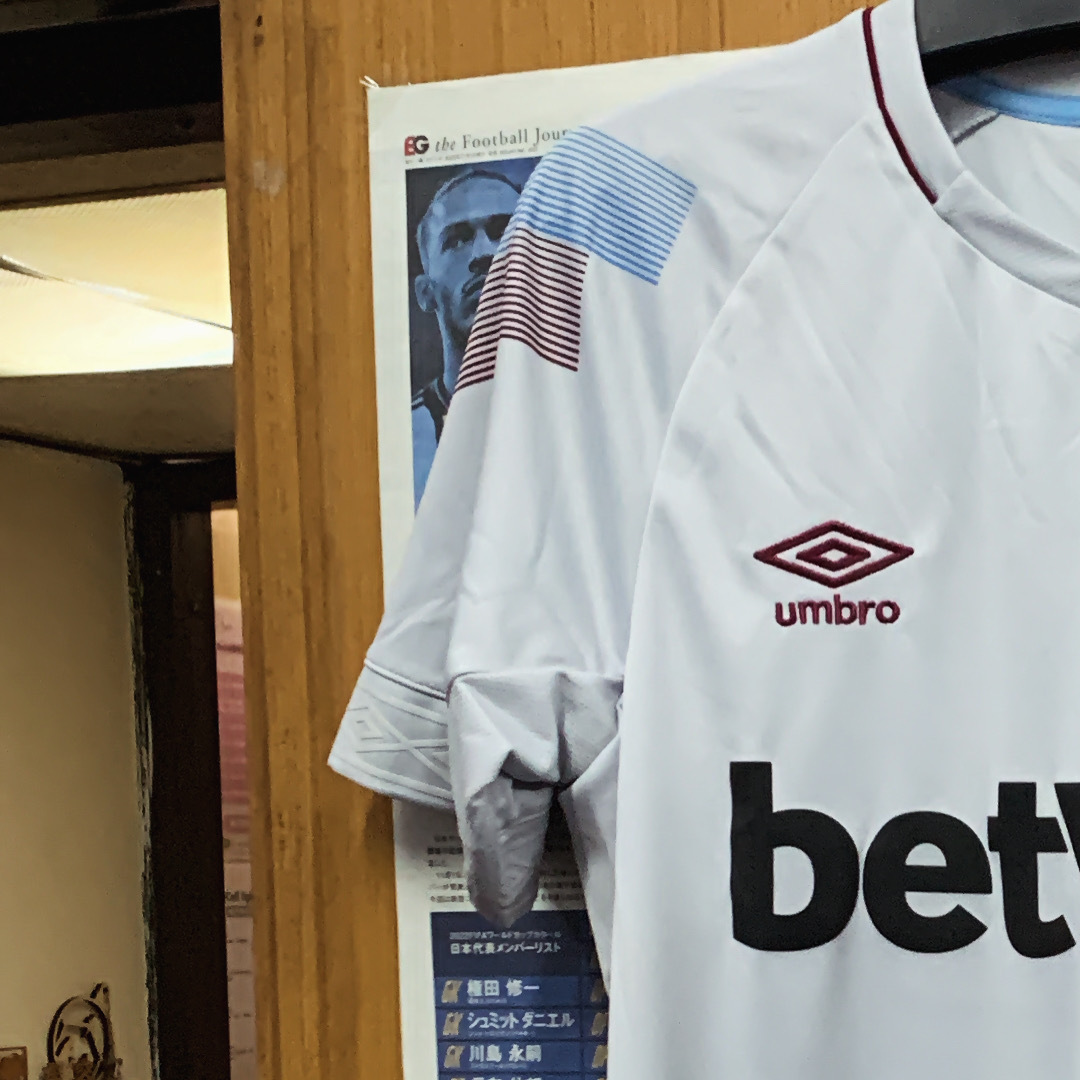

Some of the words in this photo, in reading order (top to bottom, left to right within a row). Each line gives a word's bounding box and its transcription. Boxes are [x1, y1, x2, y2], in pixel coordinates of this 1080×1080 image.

[435, 137, 456, 153] the
[462, 128, 528, 150] Football
[775, 594, 900, 627] umbro
